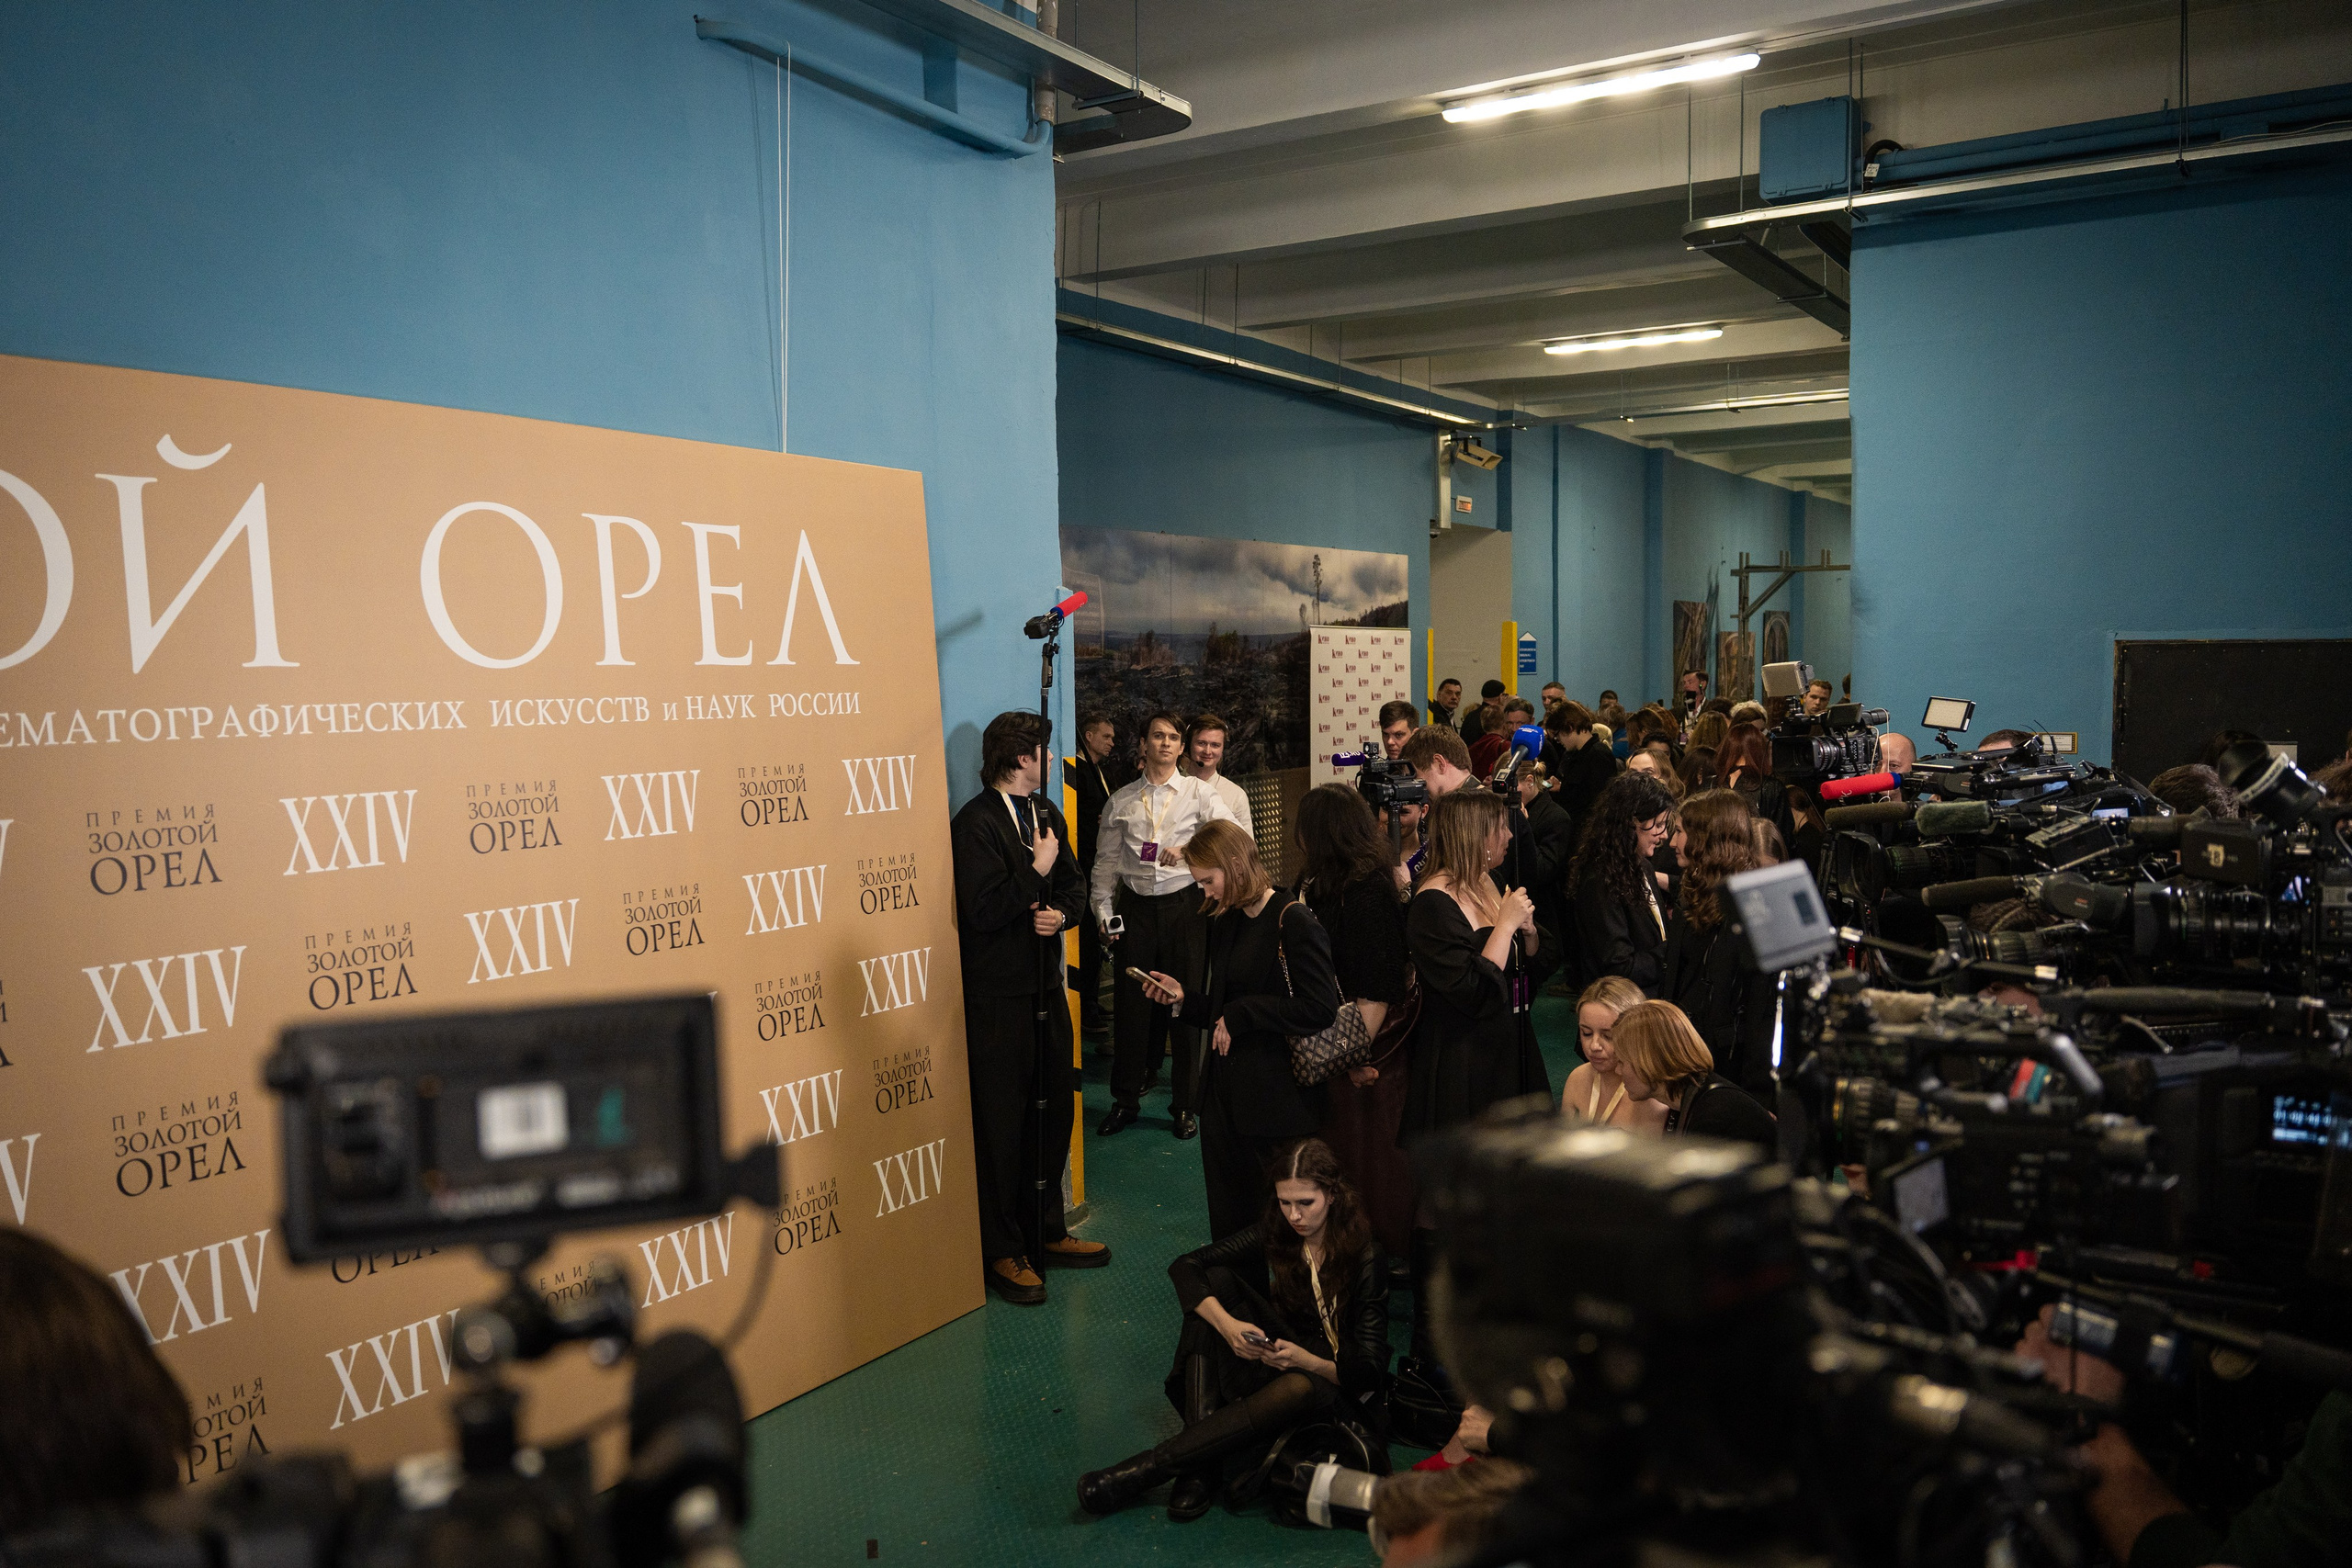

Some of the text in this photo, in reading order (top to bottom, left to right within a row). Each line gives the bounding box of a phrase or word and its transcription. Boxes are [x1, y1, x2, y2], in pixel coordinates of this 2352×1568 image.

[421, 502, 860, 669] ОРЕЛ
[490, 697, 650, 727] ИСКУССТВ
[685, 694, 756, 719] НАУК
[769, 693, 860, 716] РОССИИ
[466, 780, 557, 797] ПРЕМИЯ
[738, 763, 804, 778] ПРЕМИЯ
[740, 773, 807, 797] ЗОЛОТОЙ
[842, 755, 916, 815] XXIV
[85, 804, 215, 828] ПРЕМИЯ
[469, 794, 559, 819] ЗОЛОТОЙ
[601, 770, 700, 840] XXIV
[741, 795, 808, 827] ОРЕЛ
[88, 824, 219, 854] ЗОЛОТОЙ
[279, 789, 417, 875] XXIV
[469, 818, 561, 854] ОРЕЛ
[90, 849, 222, 896] ОРЕЛ
[857, 852, 916, 870] ПРЕМИЯ
[858, 863, 918, 887] ЗОЛОТОЙ
[623, 883, 699, 905] ПРЕМИЯ
[625, 895, 702, 925] ЗОЛОТОЙ
[742, 864, 827, 935] XXIV
[860, 884, 920, 915] ОРЕЛ
[305, 922, 413, 949] ПРЕМИЯ
[464, 898, 579, 984] XXIV
[626, 918, 705, 956] ОРЕЛ
[307, 938, 415, 974] ЗОЛОТОЙ
[83, 945, 247, 1052] XXIV
[309, 963, 418, 1010] ОРЕЛ
[755, 970, 820, 993] ПРЕМИЯ
[756, 982, 823, 1012] ЗОЛОТОЙ
[859, 947, 931, 1016] XXIV
[758, 1000, 826, 1041] ОРЕЛ
[873, 1045, 931, 1069] ПРЕМИЯ
[874, 1056, 932, 1087] ЗОЛОТОЙ
[111, 1091, 239, 1132] ПРЕМИЯ
[759, 1069, 842, 1145] XXIV
[875, 1077, 934, 1114] ОРЕЛ
[114, 1109, 243, 1157] ЗОЛОТОЙ
[116, 1136, 246, 1197] ОРЕЛ
[873, 1138, 944, 1217] XXIV
[773, 1190, 839, 1228] ЗОЛОТОЙ
[783, 1177, 837, 1205] РЕМИЯ
[775, 1210, 842, 1256] ОРЕЛ
[538, 1261, 595, 1291] ЕМИЯ
[639, 1213, 733, 1306] XXIV
[545, 1273, 597, 1306] ОТОЙ
[326, 1308, 459, 1429] XXIV
[188, 1377, 264, 1410] МИЯ
[193, 1393, 267, 1438] ОТОЙ
[187, 1424, 271, 1484] РЕЛ
